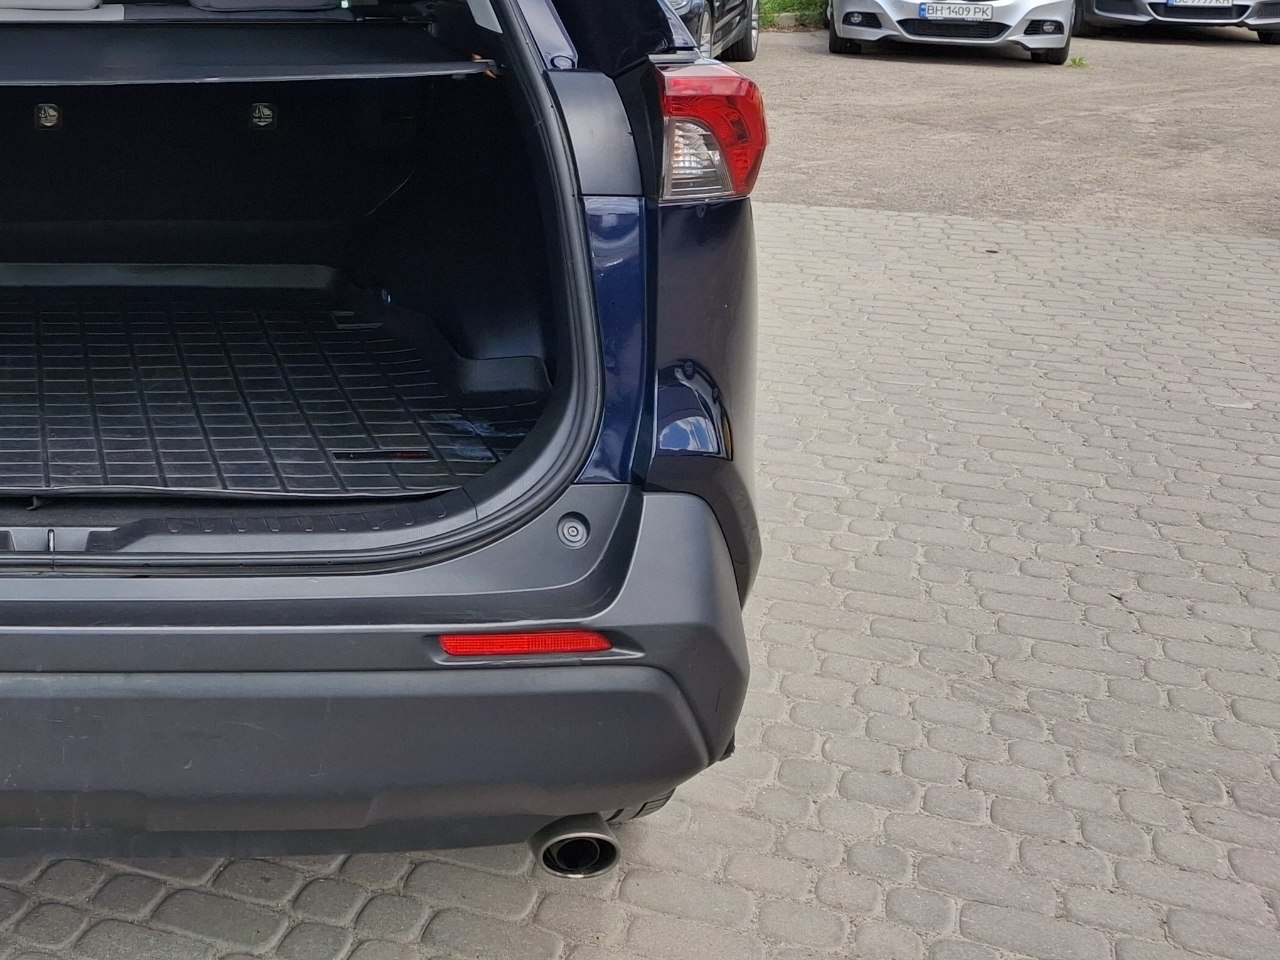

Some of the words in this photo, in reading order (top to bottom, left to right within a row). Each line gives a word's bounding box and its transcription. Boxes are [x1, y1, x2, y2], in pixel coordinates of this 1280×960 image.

[927, 5, 944, 15] BH
[946, 6, 971, 16] 1409
[973, 7, 990, 17] PK
